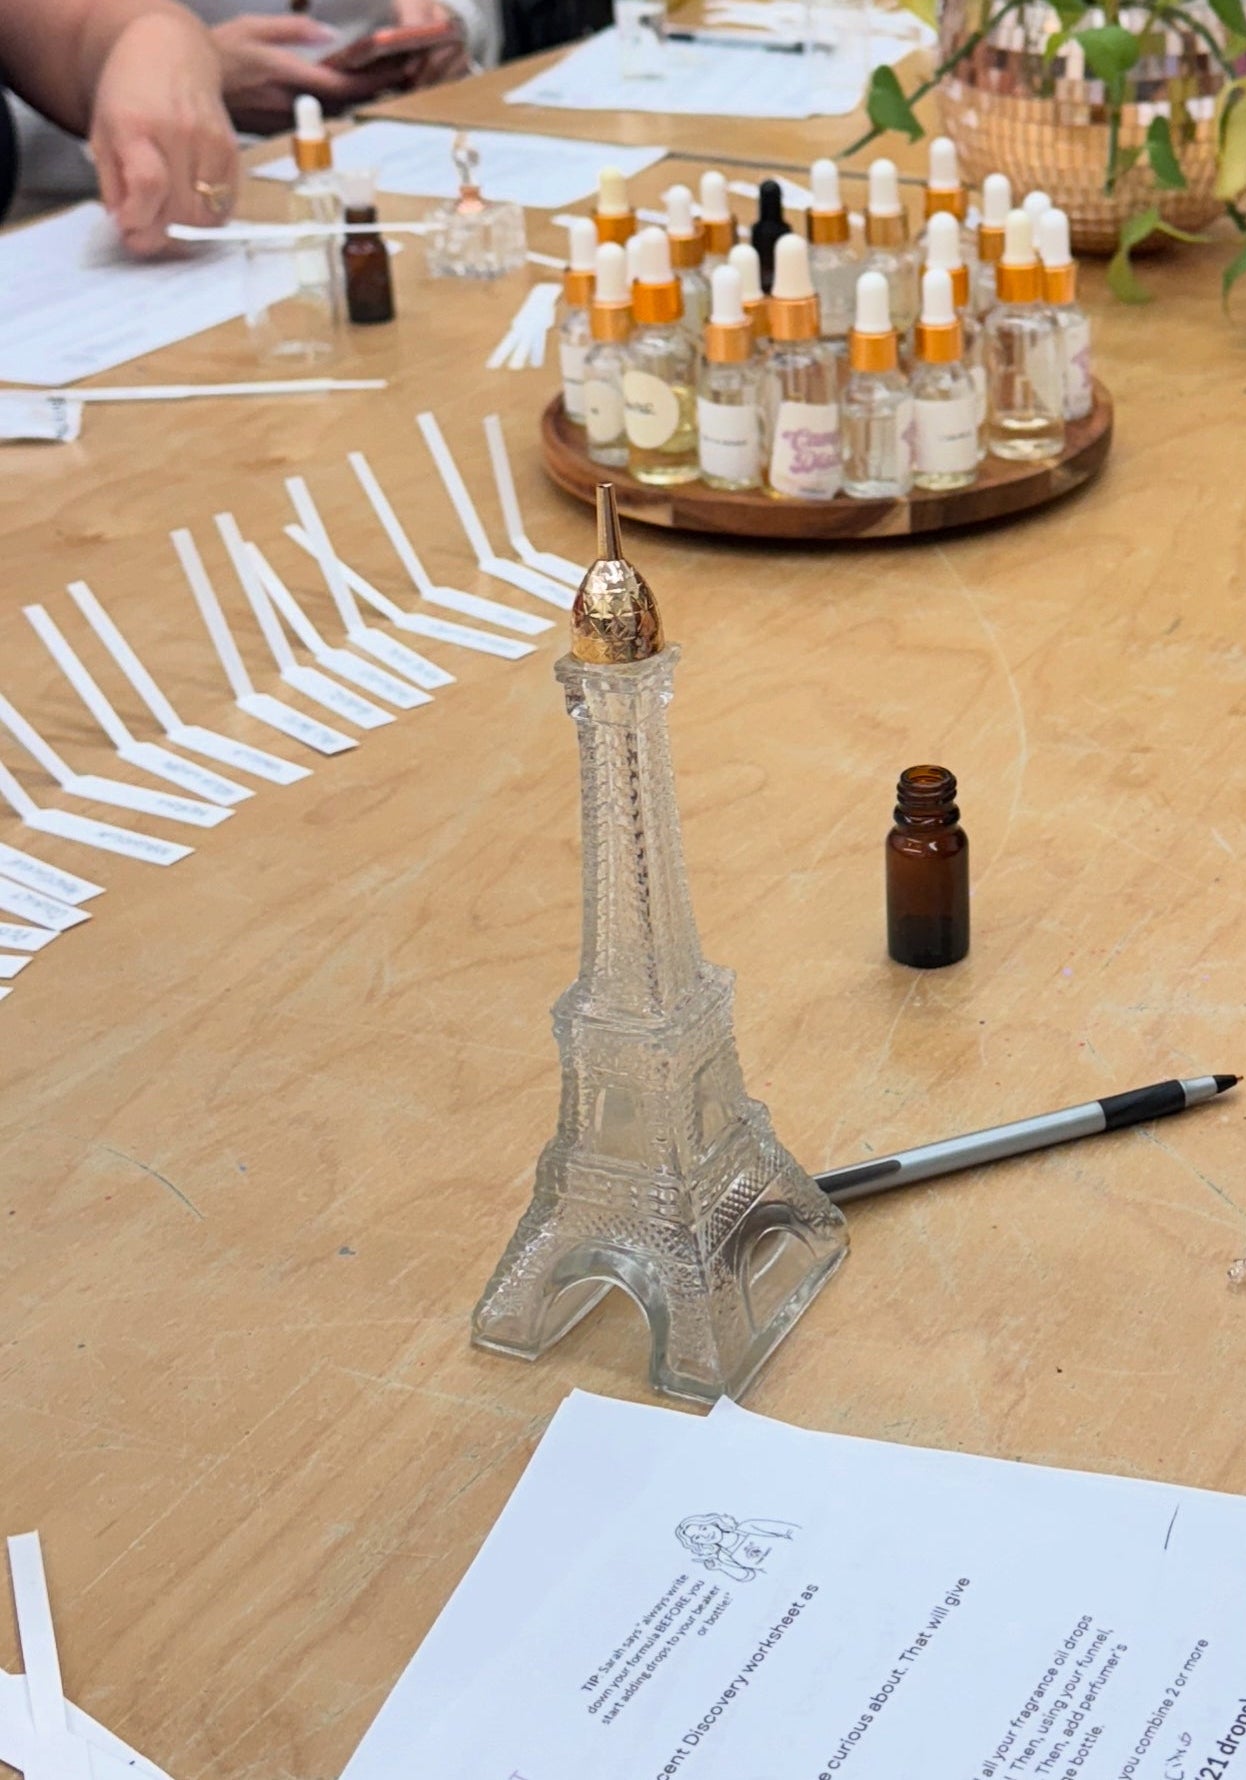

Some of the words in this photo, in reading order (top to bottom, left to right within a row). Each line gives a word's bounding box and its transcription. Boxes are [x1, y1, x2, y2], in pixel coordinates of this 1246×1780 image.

[588, 1688, 613, 1714] down
[611, 1666, 631, 1688] your
[627, 1633, 661, 1667] formula
[654, 1596, 691, 1633] BEFORE
[688, 1580, 705, 1597] you
[598, 1647, 625, 1674] Sarah
[667, 1574, 689, 1598] write
[601, 1702, 624, 1725] start
[621, 1670, 652, 1702] adding
[646, 1647, 671, 1671] drops
[667, 1635, 680, 1647] to
[676, 1615, 696, 1636] your
[691, 1585, 721, 1615] beaker
[682, 1675, 750, 1746] Discovery
[742, 1602, 805, 1673] worksheet
[801, 1583, 819, 1600] as
[697, 1627, 709, 1636] or
[827, 1713, 874, 1770] curious
[869, 1667, 909, 1712] about.
[899, 1632, 933, 1662] That
[927, 1606, 950, 1630] will
[945, 1577, 971, 1607] give
[982, 1759, 999, 1777] all
[992, 1730, 1017, 1762] your
[1010, 1667, 1058, 1728] fragrance
[1054, 1650, 1069, 1666] oil
[1064, 1614, 1093, 1650] drops
[1009, 1737, 1046, 1771] Then,
[1037, 1699, 1069, 1735] using
[1060, 1669, 1084, 1699] your
[1076, 1628, 1115, 1670] funnel,
[1034, 1740, 1070, 1774] Then,
[1063, 1710, 1085, 1737] add
[1079, 1643, 1128, 1711] perfumer's
[1118, 1756, 1140, 1780] you
[1134, 1699, 1174, 1755] combine
[1165, 1687, 1180, 1697] 2
[1174, 1673, 1189, 1687] or
[1183, 1639, 1209, 1672] more
[1195, 1757, 1229, 1780] 21
